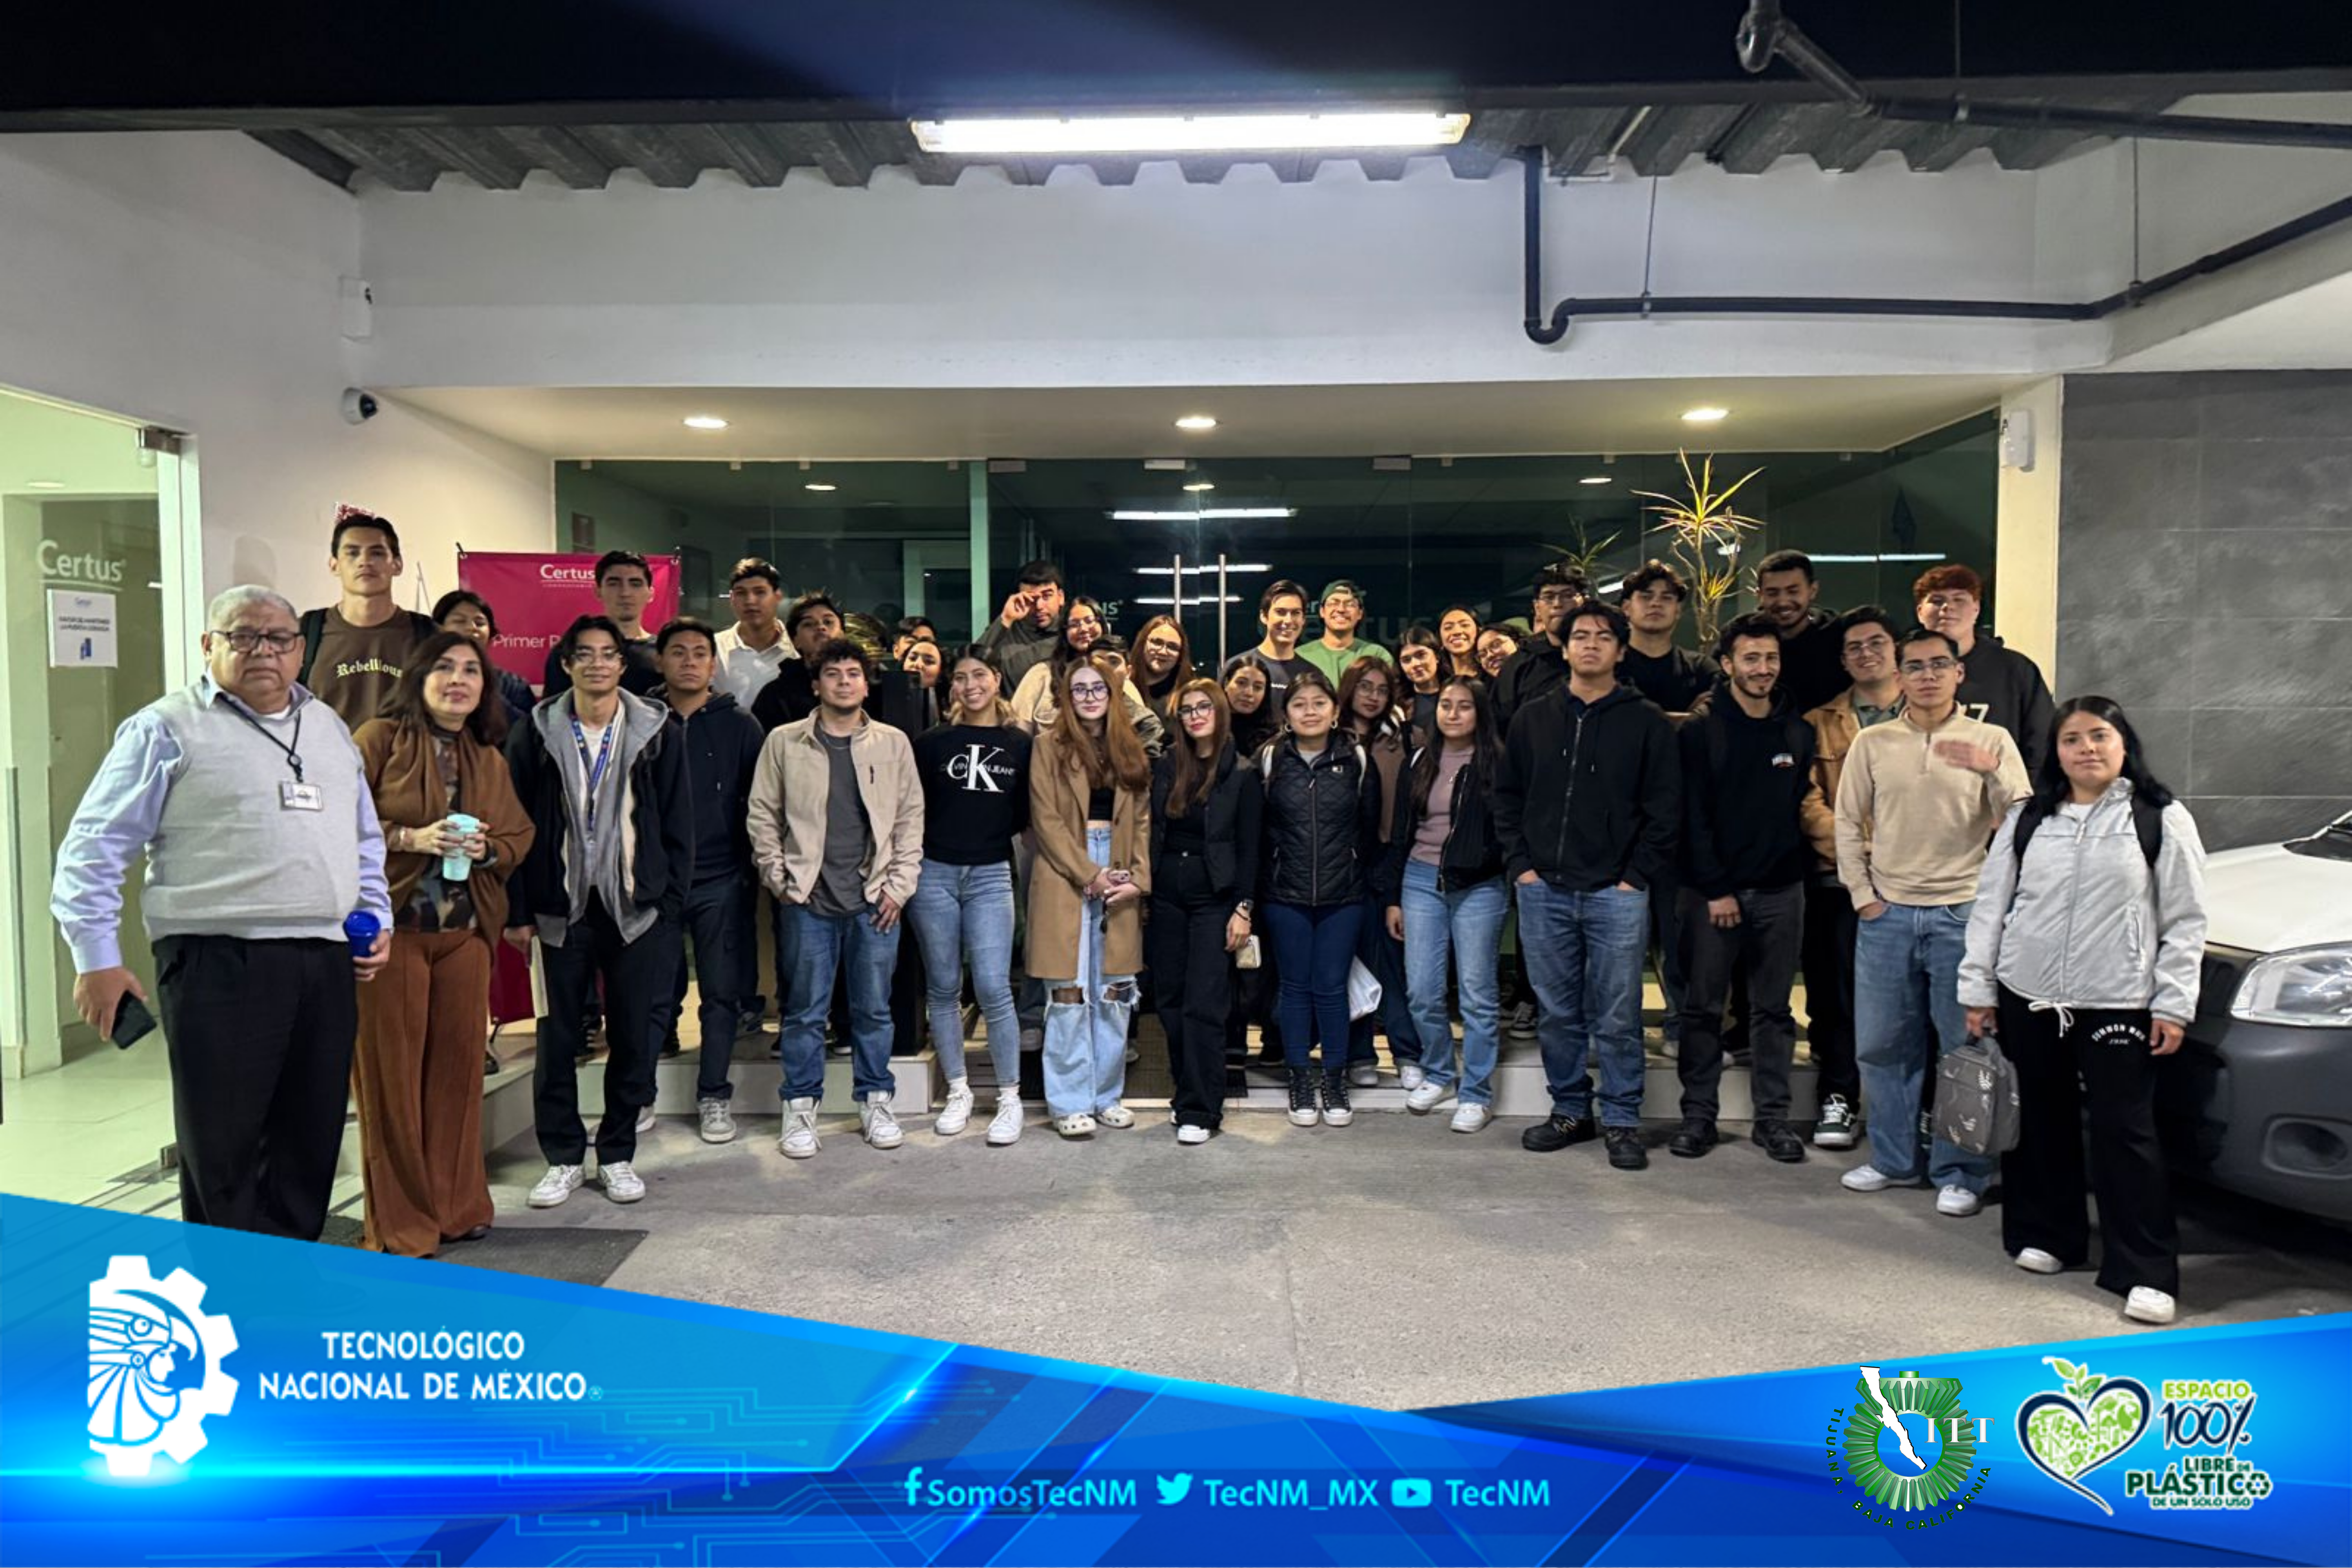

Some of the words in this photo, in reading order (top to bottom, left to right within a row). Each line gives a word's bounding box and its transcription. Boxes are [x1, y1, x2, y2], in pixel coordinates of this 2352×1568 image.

[37, 539, 122, 582] Certus
[540, 563, 595, 579] Certus
[492, 633, 545, 647] Primer
